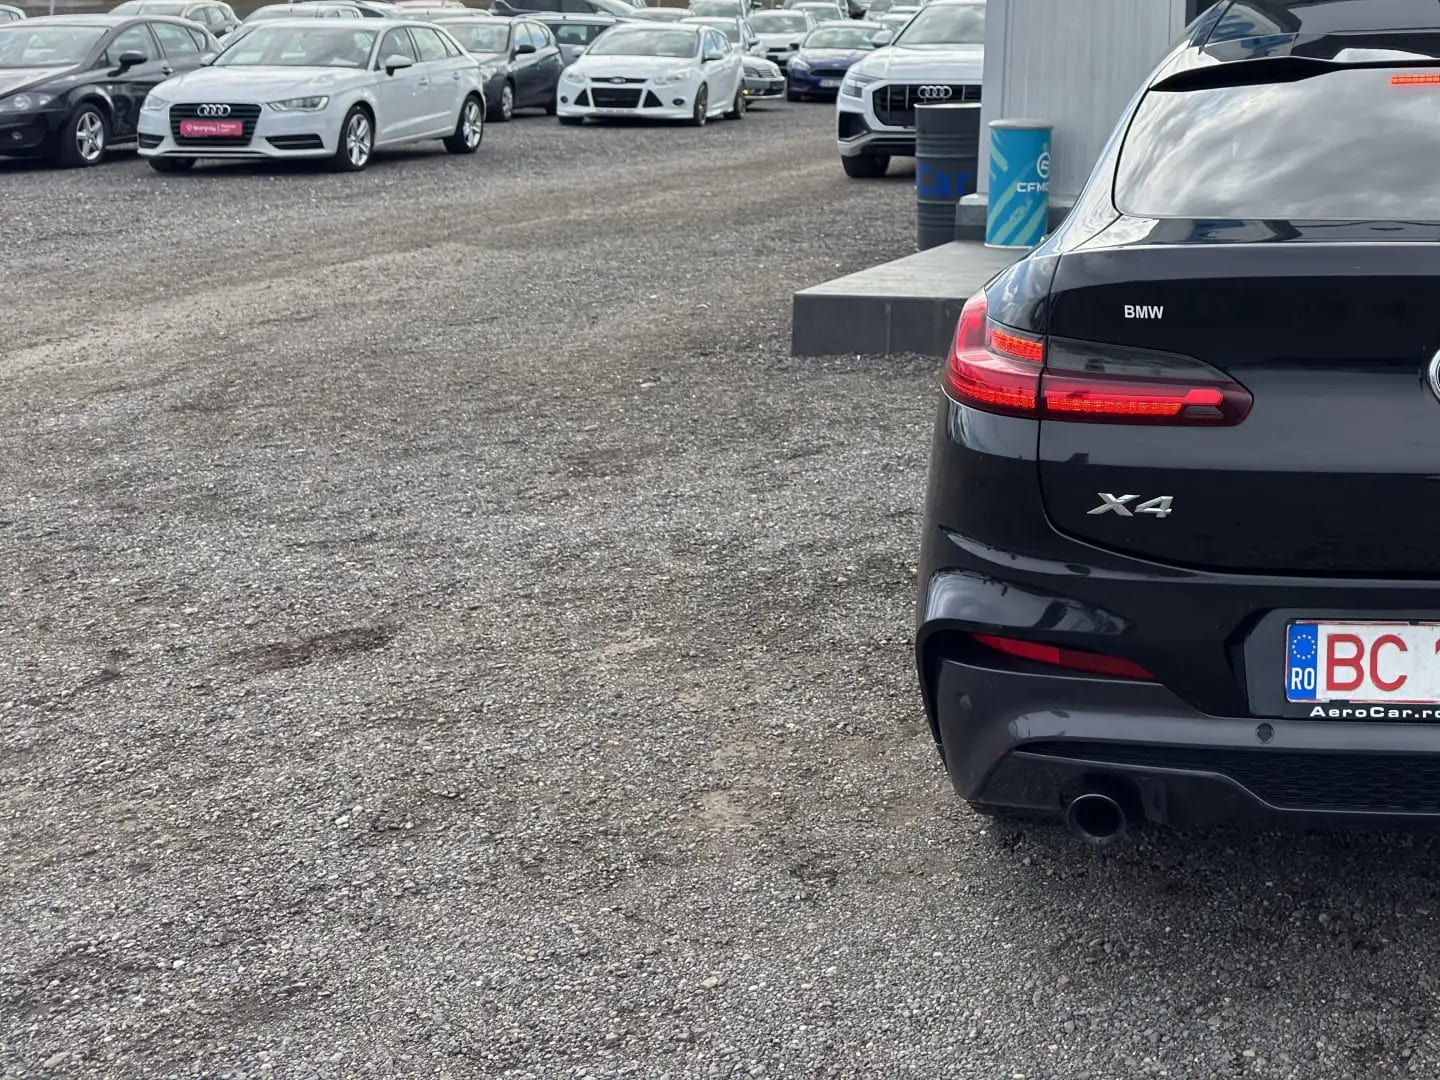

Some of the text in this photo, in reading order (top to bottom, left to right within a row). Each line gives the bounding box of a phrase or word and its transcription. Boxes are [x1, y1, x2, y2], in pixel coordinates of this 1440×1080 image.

[1124, 304, 1164, 319] BMW
[1086, 492, 1174, 518] X4
[1326, 633, 1409, 692] BC
[1290, 667, 1316, 691] RO
